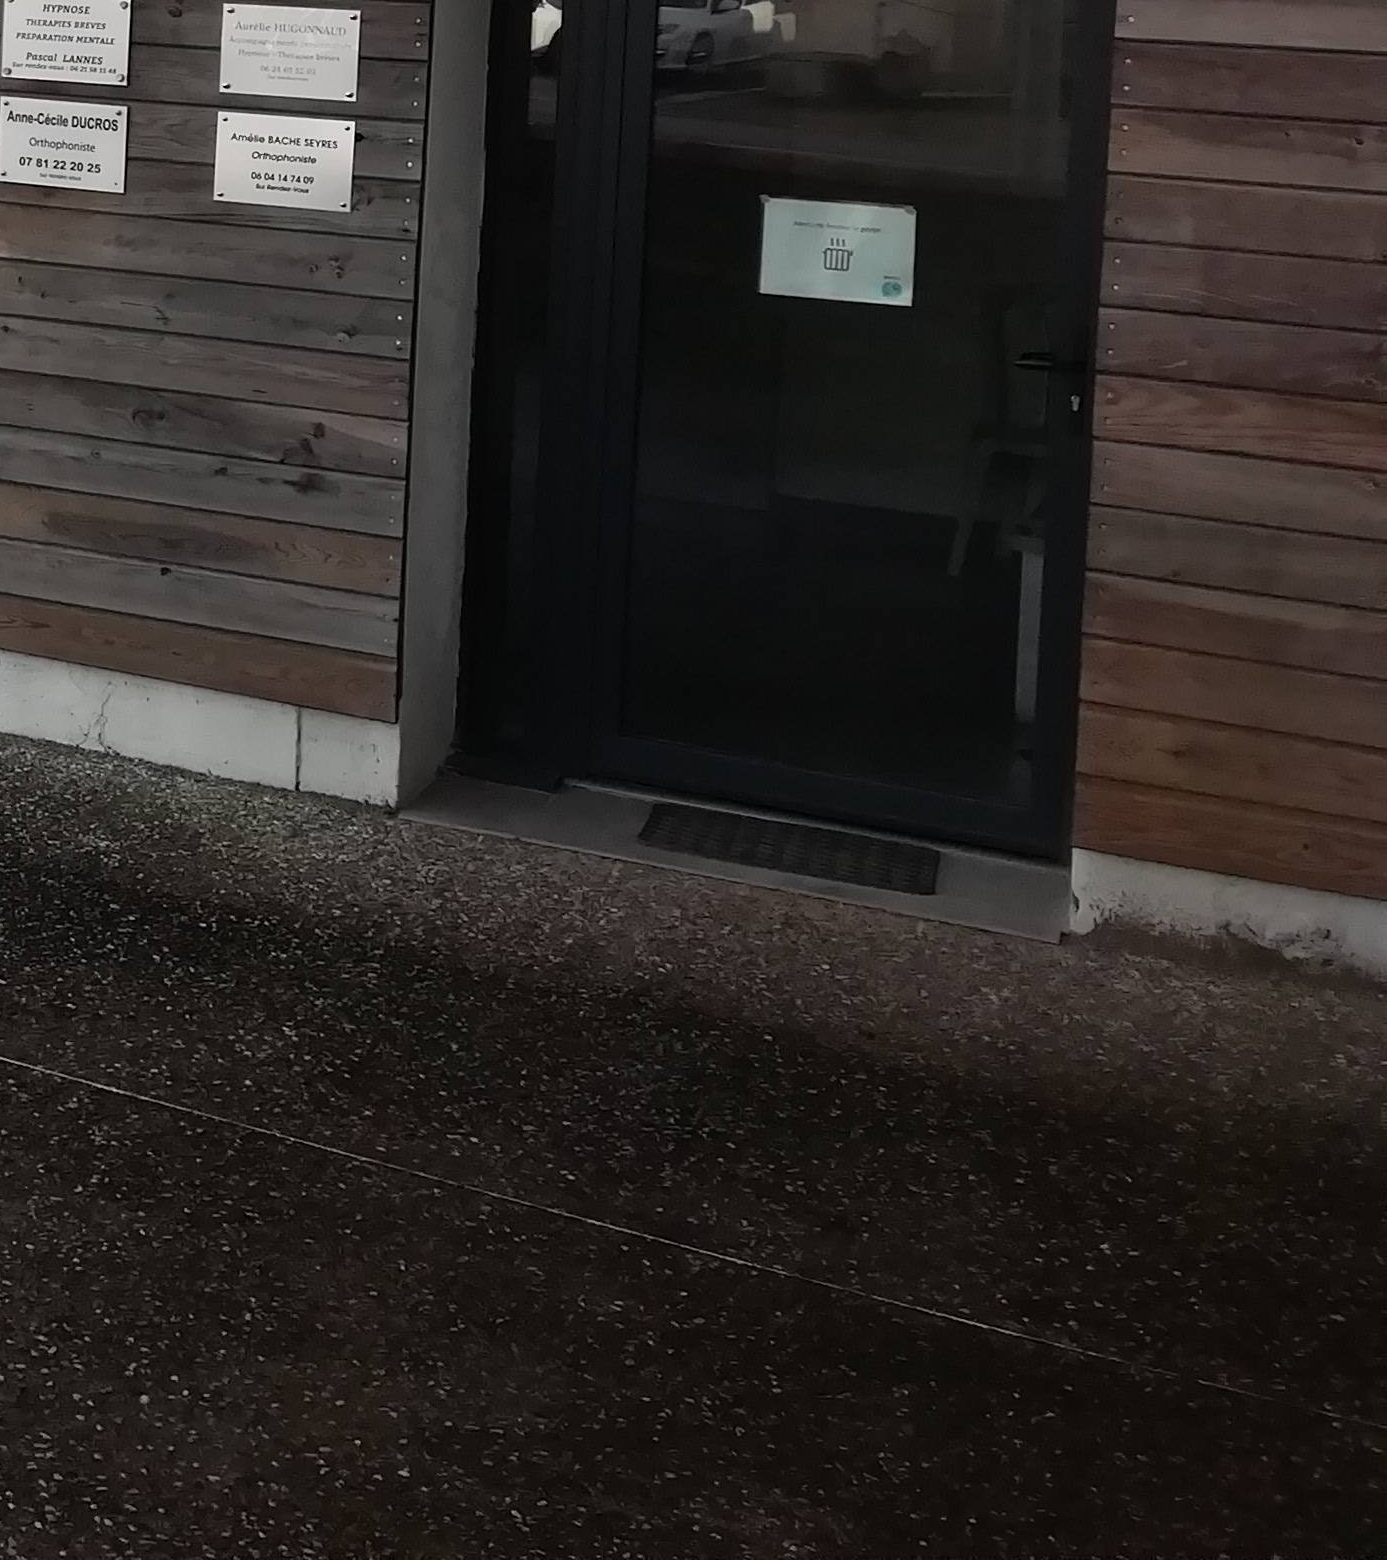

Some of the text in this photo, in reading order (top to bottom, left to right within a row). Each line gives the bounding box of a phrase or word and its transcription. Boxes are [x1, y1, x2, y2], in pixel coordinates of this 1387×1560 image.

[42, 4, 91, 15] HYPNOSE
[26, 18, 107, 30] THERAPIES BREVES
[234, 21, 347, 37] Aurélie HUGONNAUD
[16, 32, 116, 46] PREPARATION MENTALE
[26, 52, 104, 65] Pascal LANNES
[7, 110, 119, 132] Anne-Cécile DUCROS
[29, 137, 96, 153] Orthophoniste
[231, 132, 339, 149] Amélie BACHE SEYRES
[19, 156, 102, 174] 07 81 22 20 25
[251, 151, 317, 165] Orthophoniste
[250, 171, 315, 185] 06 04 14 74 09
